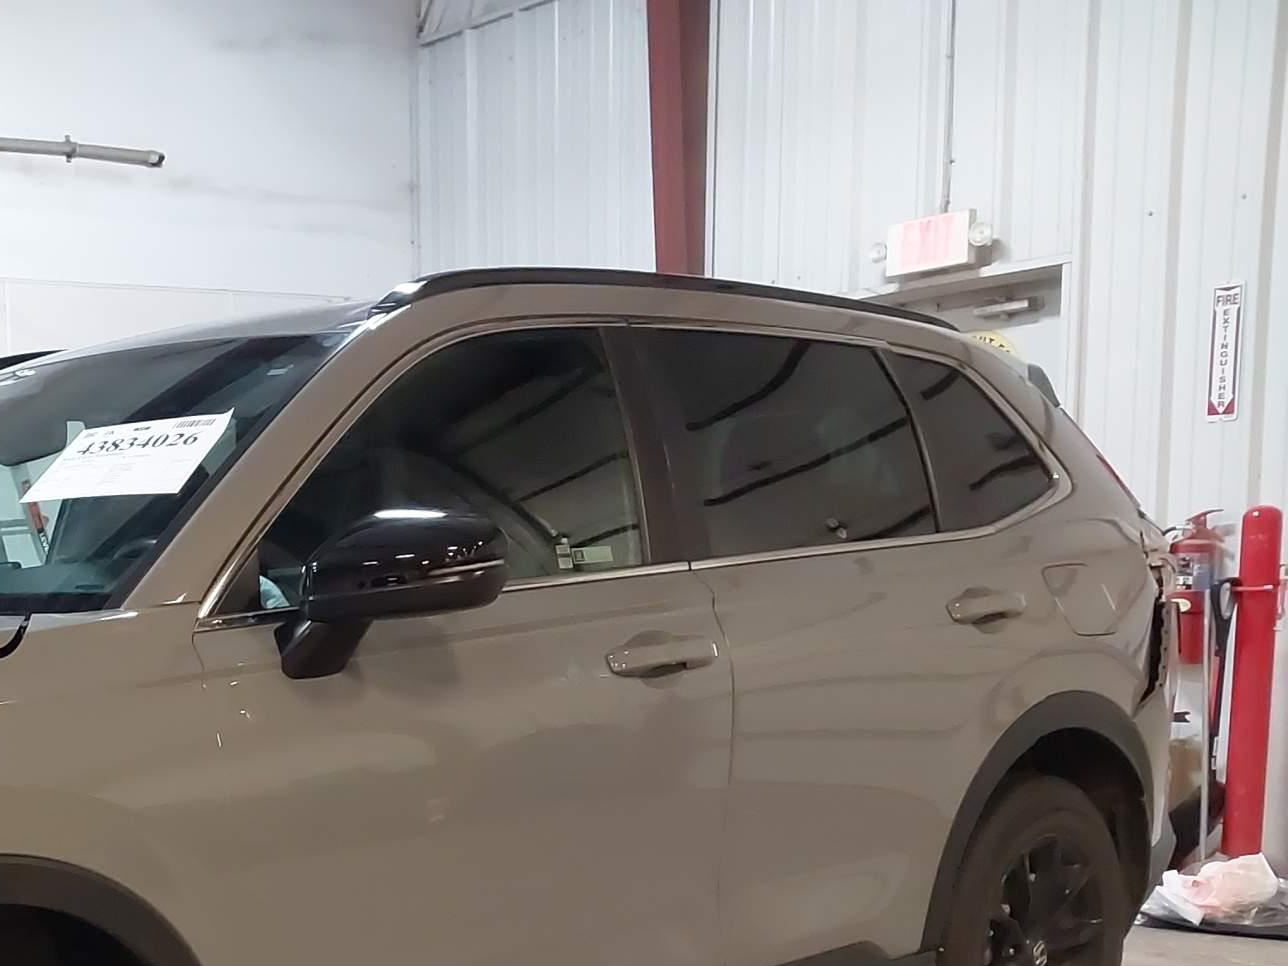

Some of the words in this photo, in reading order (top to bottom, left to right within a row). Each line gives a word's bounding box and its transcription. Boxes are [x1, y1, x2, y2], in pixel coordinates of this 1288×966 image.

[1216, 293, 1240, 307] FIRE
[1217, 308, 1230, 408] EXTINGUISHER
[76, 431, 202, 455] 43834026
